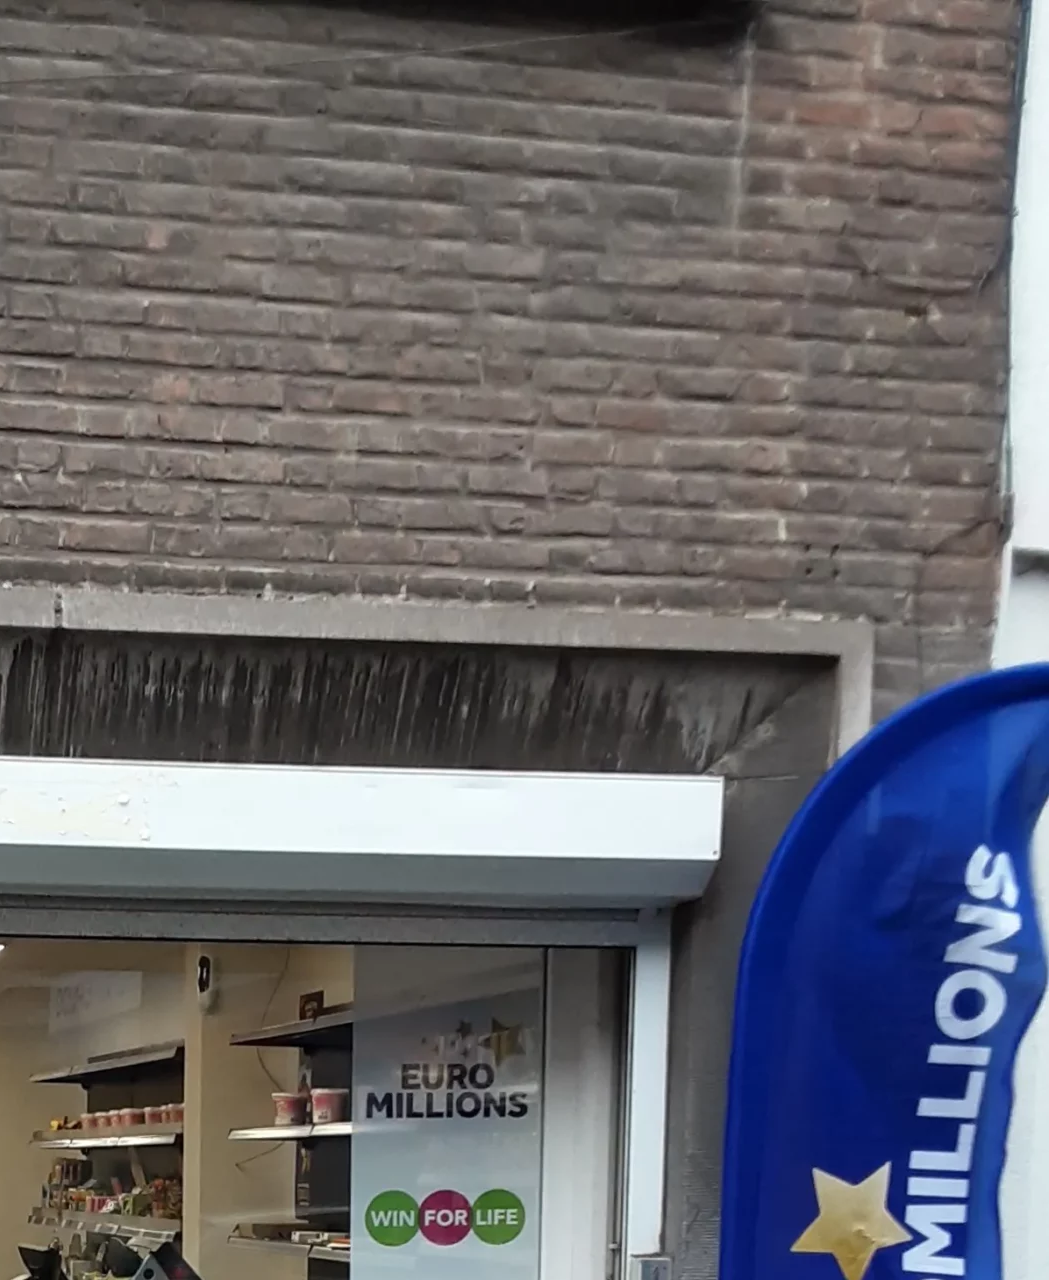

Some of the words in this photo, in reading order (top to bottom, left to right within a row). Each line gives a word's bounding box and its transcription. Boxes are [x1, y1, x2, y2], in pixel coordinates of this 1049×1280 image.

[401, 1063, 495, 1091] EURO
[365, 1091, 529, 1119] MILLIONS
[371, 1209, 415, 1228] WIN
[424, 1208, 468, 1227] FOR
[475, 1208, 519, 1227] LIFE
